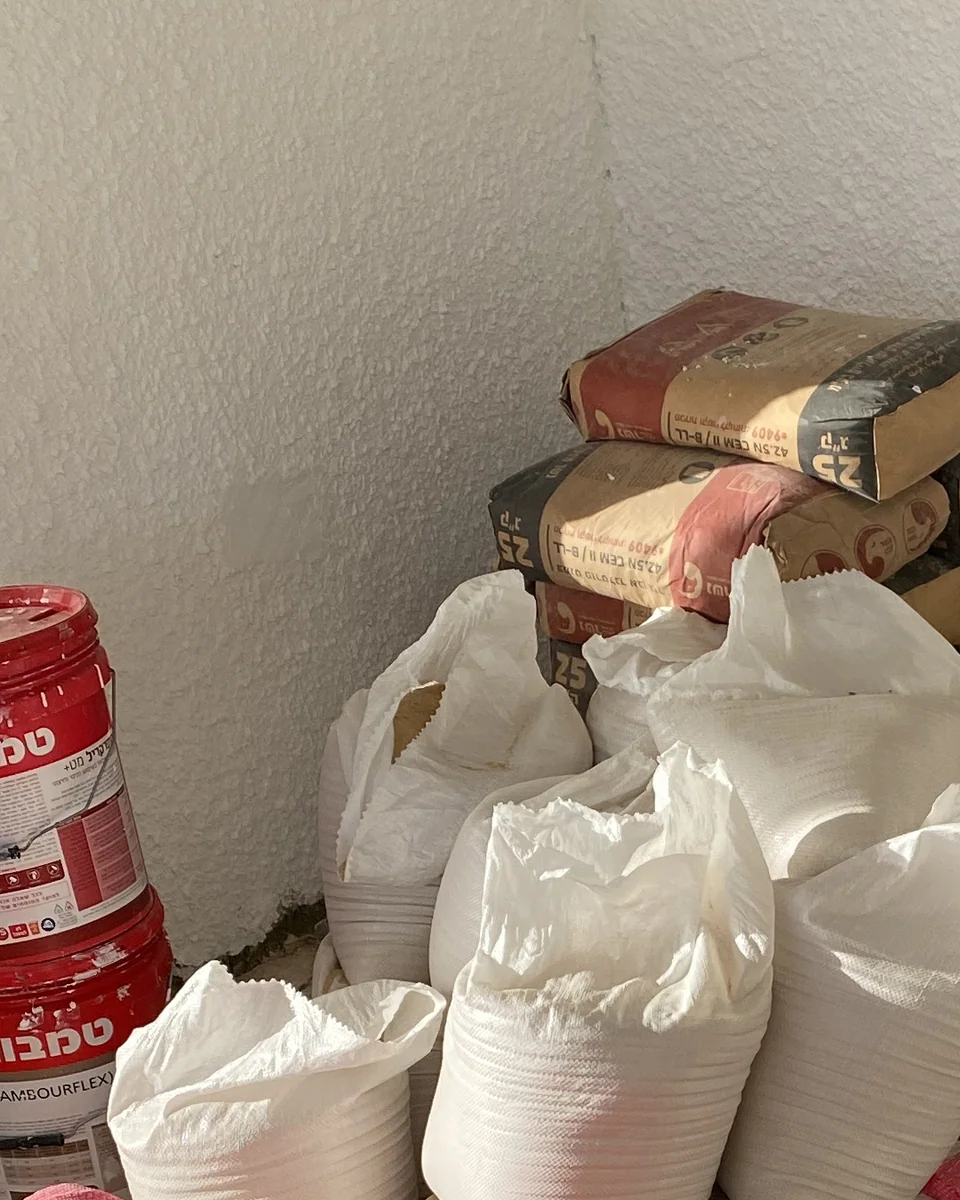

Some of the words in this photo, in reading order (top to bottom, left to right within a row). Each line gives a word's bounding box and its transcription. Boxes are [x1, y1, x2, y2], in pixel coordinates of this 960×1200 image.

[674, 427, 703, 444] B-LL
[723, 438, 750, 452] CEM
[753, 443, 789, 458] 42.5N
[812, 454, 863, 488] 25
[497, 530, 535, 568] 25
[552, 541, 580, 558] B-LL
[599, 550, 625, 568] CEM
[627, 560, 662, 575] 42.5N
[555, 651, 588, 690] 25
[0, 1017, 114, 1063] טמבו
